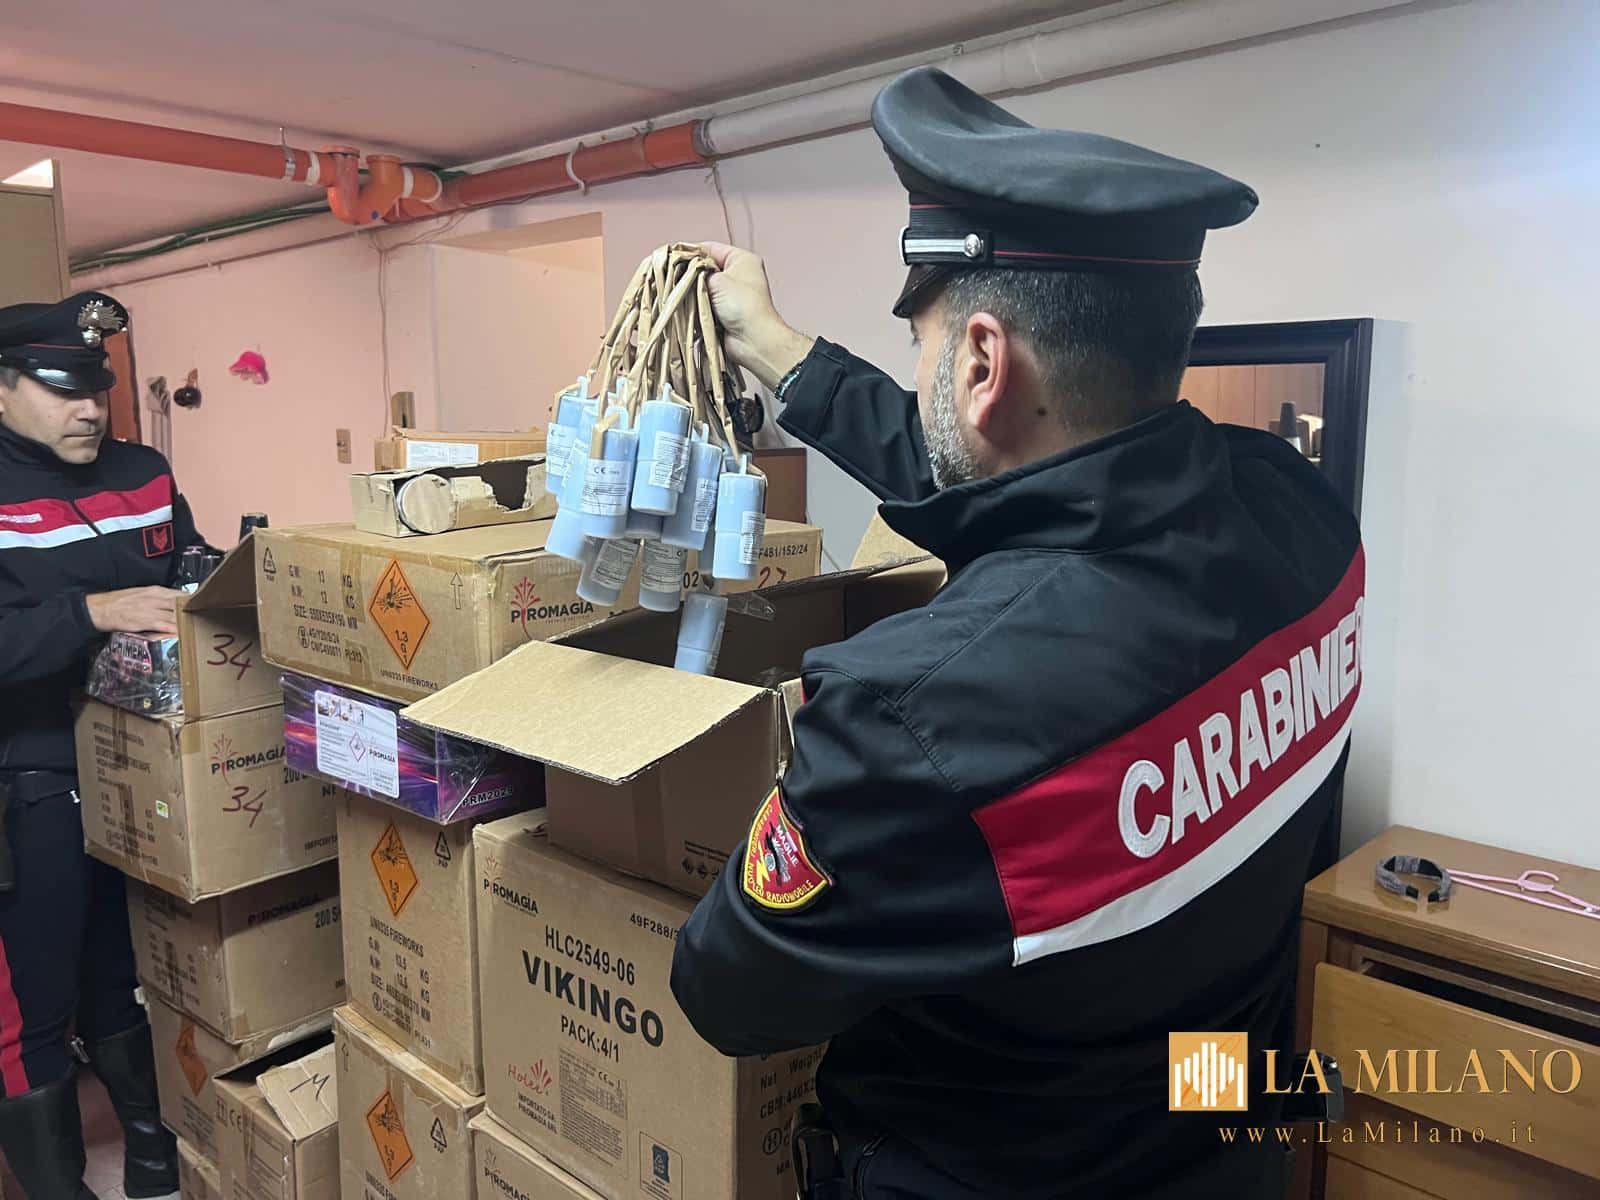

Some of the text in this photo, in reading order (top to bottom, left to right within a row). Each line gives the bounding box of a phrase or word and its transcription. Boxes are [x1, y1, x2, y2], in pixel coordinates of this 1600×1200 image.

[511, 601, 594, 624] PIROMAGIA
[206, 633, 253, 681] 34
[402, 674, 439, 692] FIREWORKS
[222, 786, 267, 829] 34
[776, 824, 800, 868] MAGLIE
[544, 924, 636, 987] HLC2549-06
[521, 949, 664, 1048] VIKINGO
[560, 1014, 620, 1063] PACK:4/1
